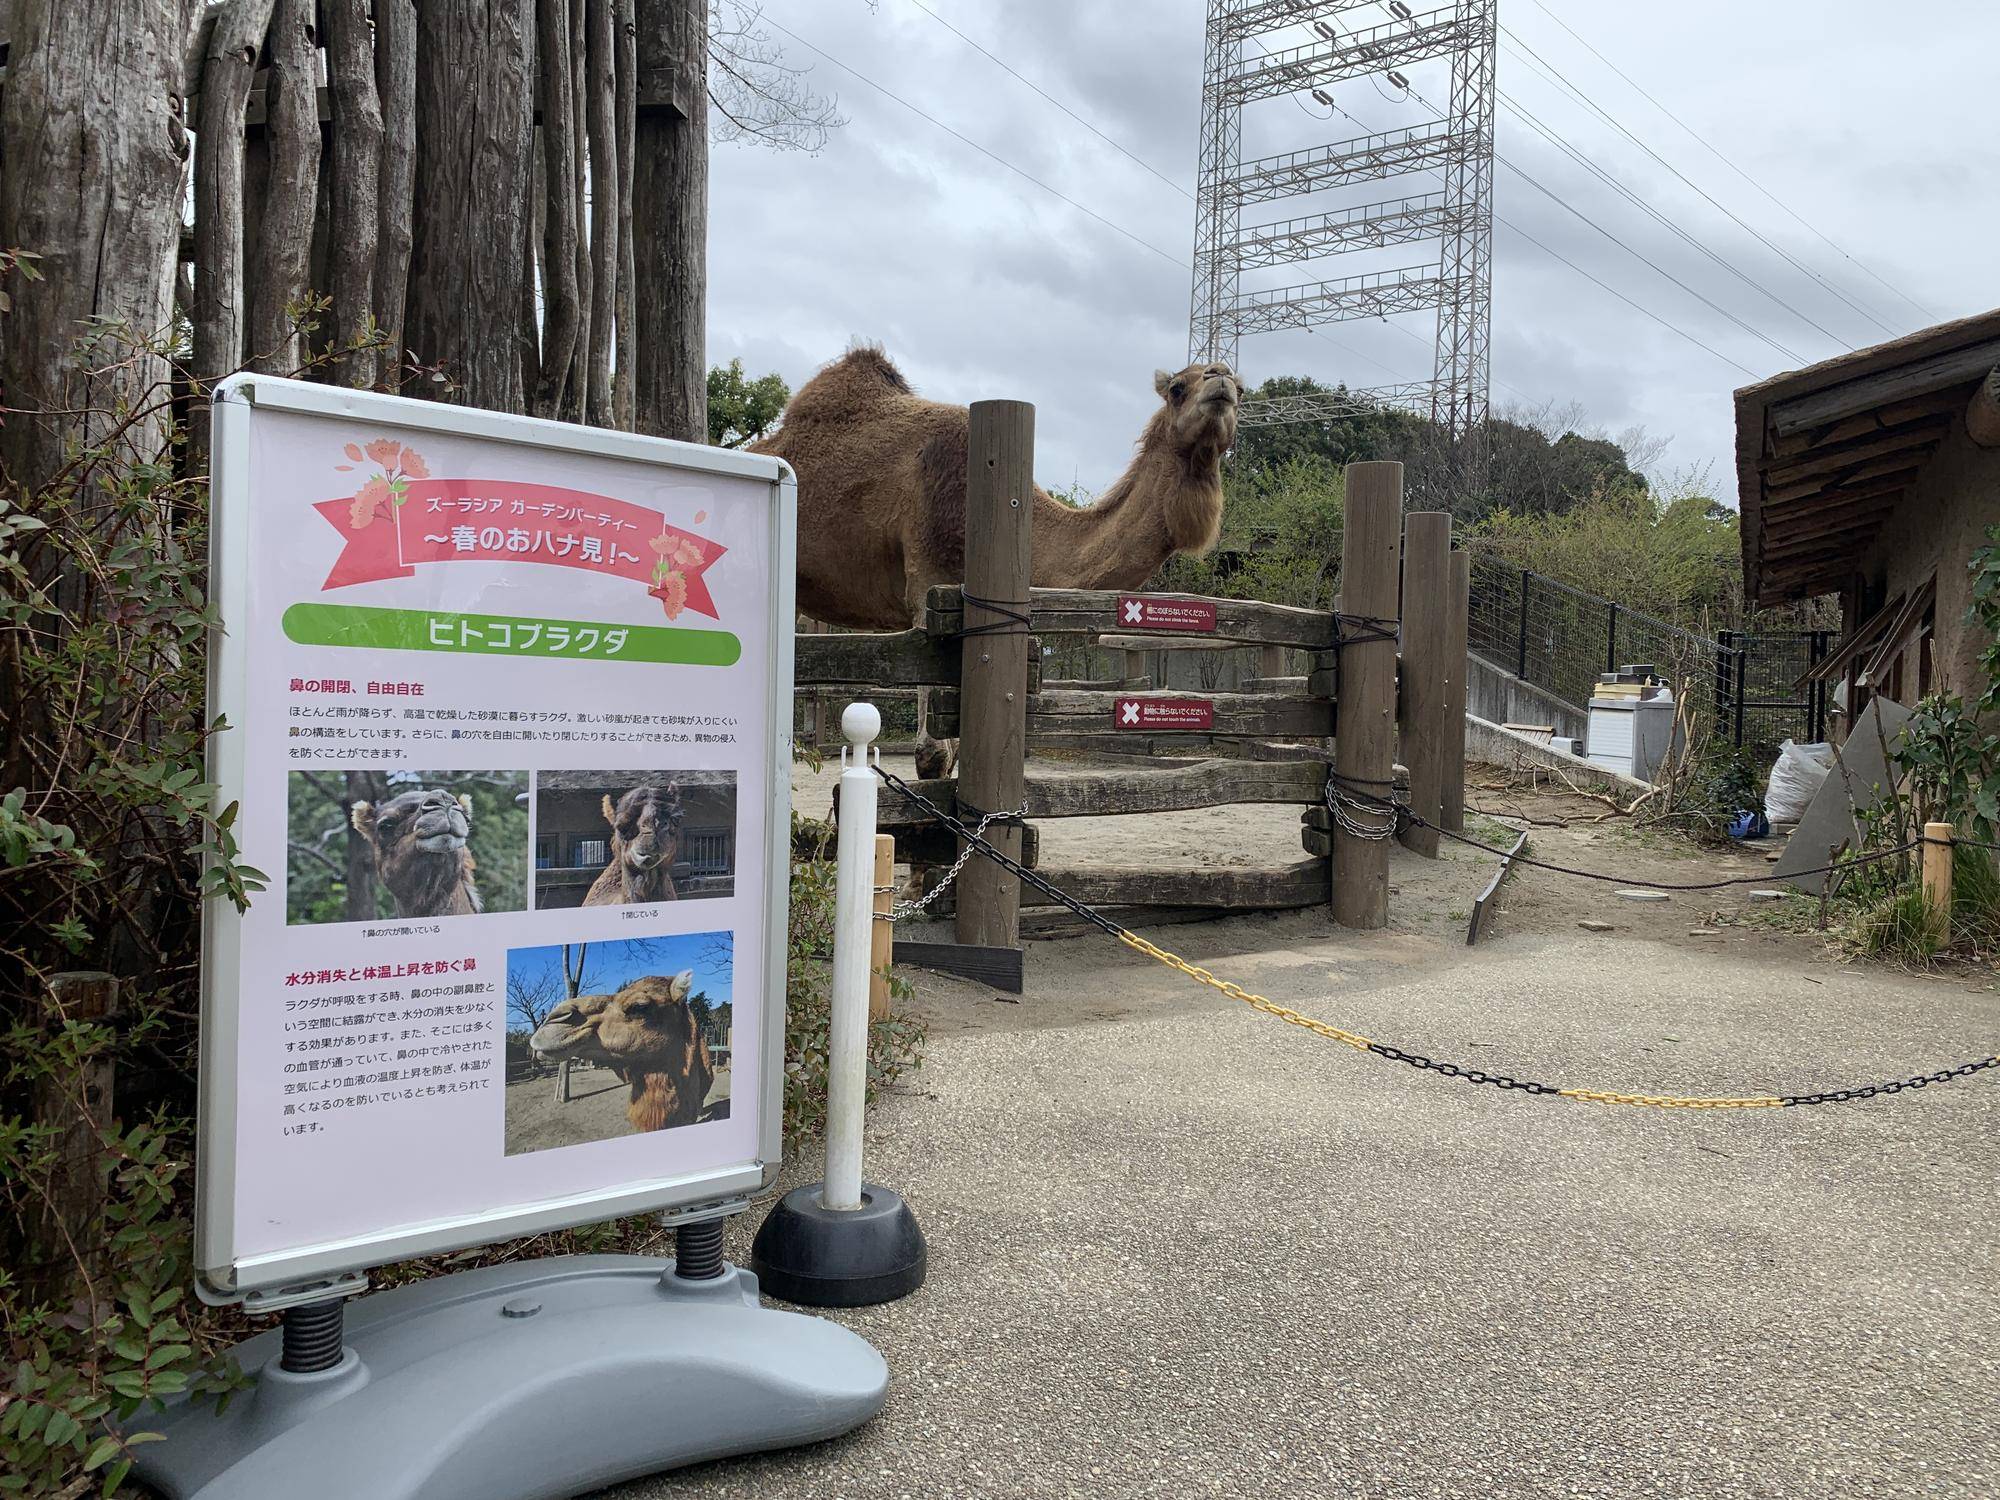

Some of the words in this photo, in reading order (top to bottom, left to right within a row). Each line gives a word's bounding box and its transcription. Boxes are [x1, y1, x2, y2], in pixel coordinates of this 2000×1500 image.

[426, 496, 504, 516] ズーラシア
[510, 499, 638, 532] ガーデンパーティー
[429, 617, 629, 654] ヒトコブラクダ
[289, 678, 425, 696] 鼻の開閉、自由自在
[288, 747, 409, 760] を防ぐことができます。
[367, 925, 441, 938] 鼻の穴が開いている
[284, 958, 477, 987] 水分消失と体温上昇を防ぐ鼻
[284, 982, 496, 1012] ラクダが呼吸をする時、鼻の中の副鼻腔と
[284, 1001, 496, 1032] いう空間に結露ができ、水分の消失を少なく
[284, 1020, 494, 1053] する効果があります。また、そこには多く
[283, 1040, 493, 1074] の血管が通っていて、鼻の中で冷やされた
[283, 1058, 492, 1095] 空気により血液の温度上昇を防ぎ、体温が
[283, 1078, 490, 1116] 高くなるのを防いでいるとも考えられて
[283, 1122, 325, 1137] います。
